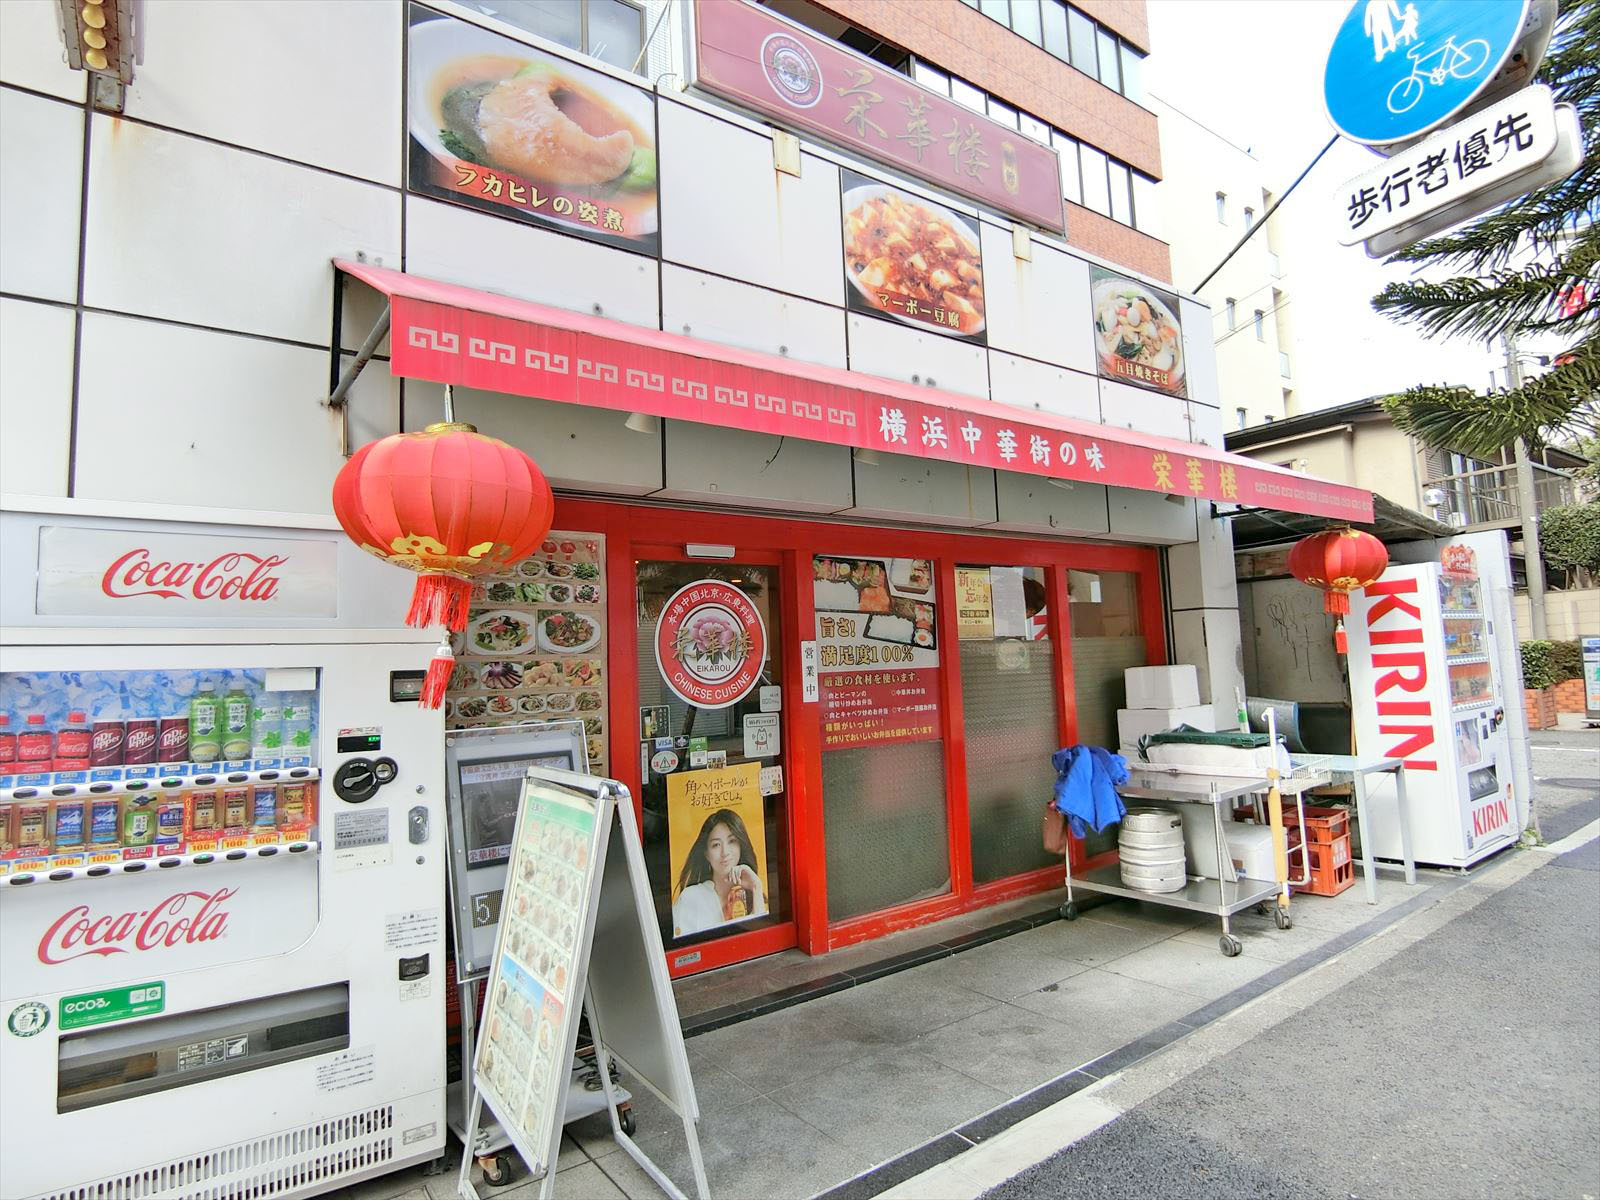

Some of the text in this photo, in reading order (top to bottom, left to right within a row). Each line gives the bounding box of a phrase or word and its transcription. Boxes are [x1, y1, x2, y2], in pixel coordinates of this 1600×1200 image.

[1348, 112, 1534, 230] 歩行者優先
[455, 165, 625, 233] フカヒレの姿煮
[876, 291, 960, 328] マーボー豆腐
[879, 407, 1106, 470] 横浜中華街の味
[1152, 453, 1238, 500] 栄華楼
[101, 547, 290, 601] Coca-Cola
[696, 664, 731, 673] EIKAROU
[804, 646, 816, 696] 営業中
[820, 645, 914, 667] 満足度100%
[1364, 577, 1438, 772] KIRIN
[674, 671, 752, 701] CHINESE CUISINE
[657, 737, 673, 747] VISA
[685, 776, 748, 797] 角ハイボールが
[1473, 799, 1509, 838] KIRIN
[37, 886, 240, 965] Coca-Cola
